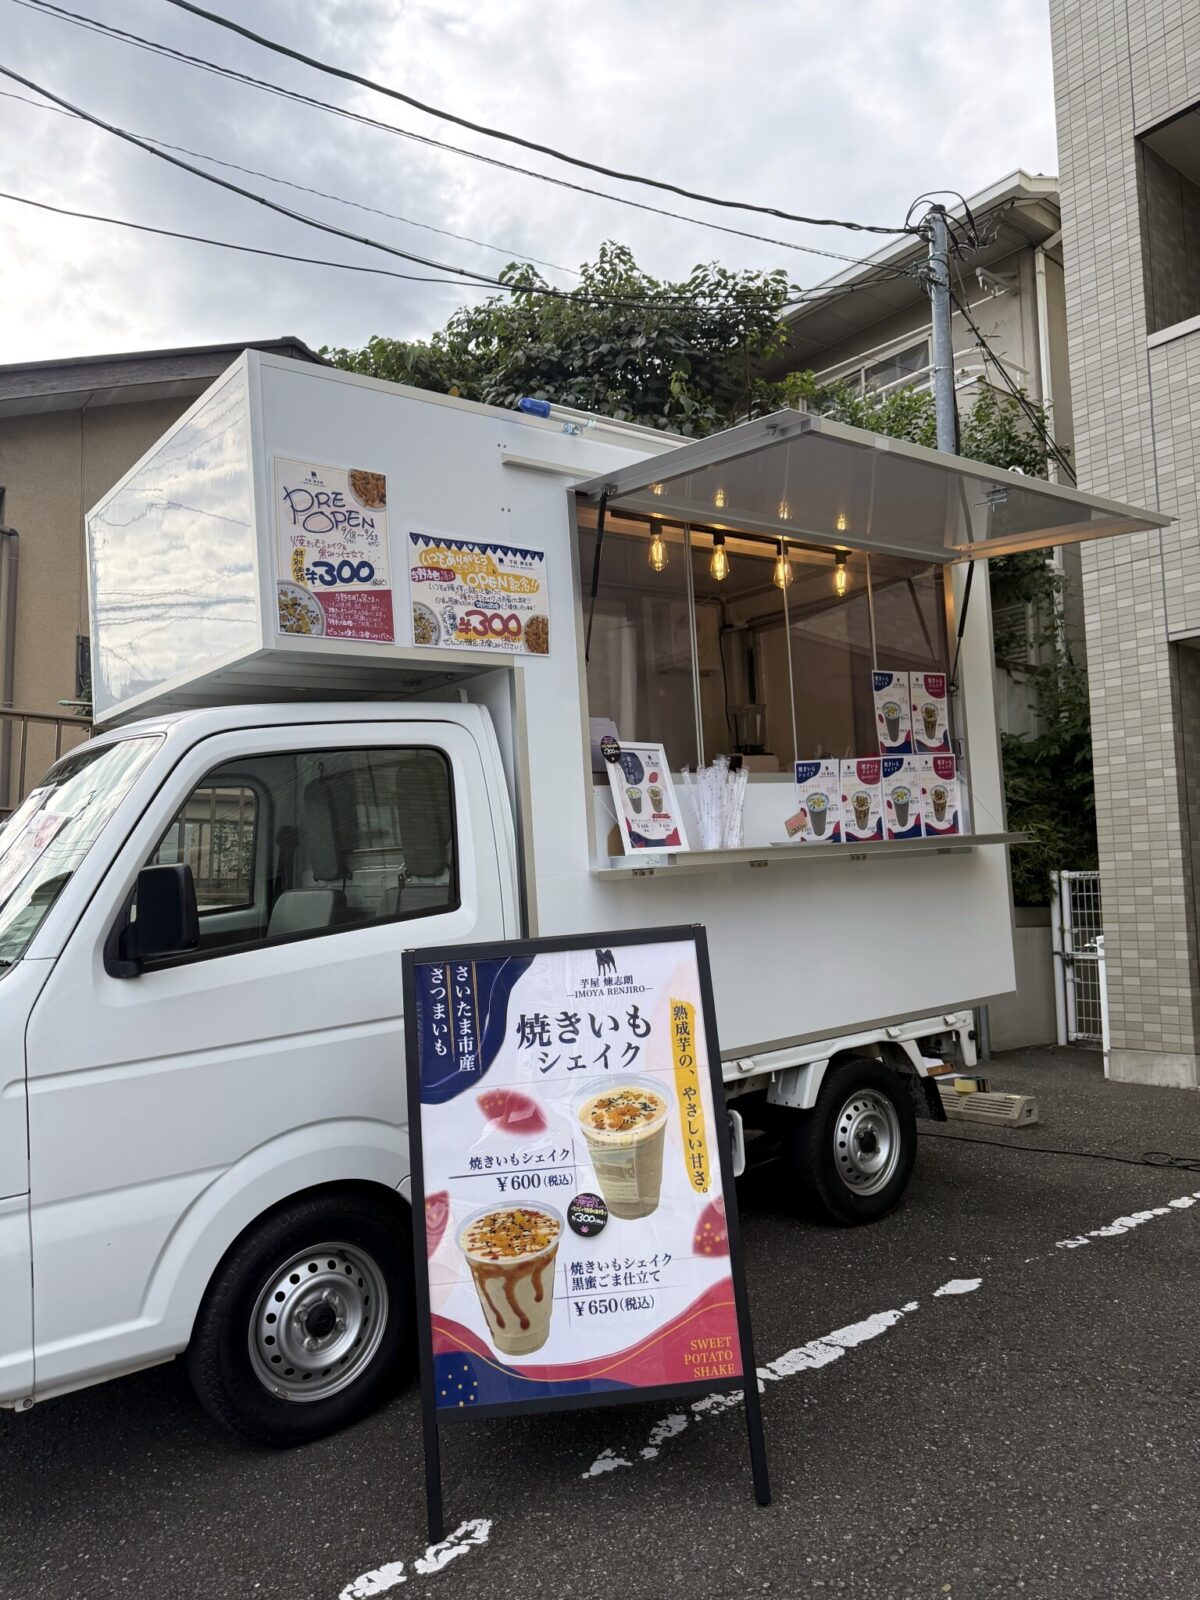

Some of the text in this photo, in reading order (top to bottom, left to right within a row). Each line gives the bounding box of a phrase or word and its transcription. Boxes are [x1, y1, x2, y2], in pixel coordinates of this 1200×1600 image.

[283, 486, 346, 525] PRE
[303, 510, 375, 533] OPEN
[575, 985, 645, 998] IMOYA RENJIRO
[580, 978, 600, 988] 芋屋
[429, 967, 448, 1056] さつまいも
[456, 965, 476, 1073] さいたま市産
[516, 1004, 652, 1050] 焼きいも
[538, 1041, 641, 1074] シェイク
[672, 1004, 709, 1194] 熟成芋の、やさしい甘さ。
[469, 1148, 570, 1171] 焼きいもシェイク
[570, 1252, 672, 1276] 焼きいもシェイク
[571, 1269, 662, 1292] 黒蜜ごま仕立て
[690, 1336, 732, 1351] SWEET
[684, 1350, 733, 1366] POTATO
[693, 1364, 735, 1379] SHAKE
